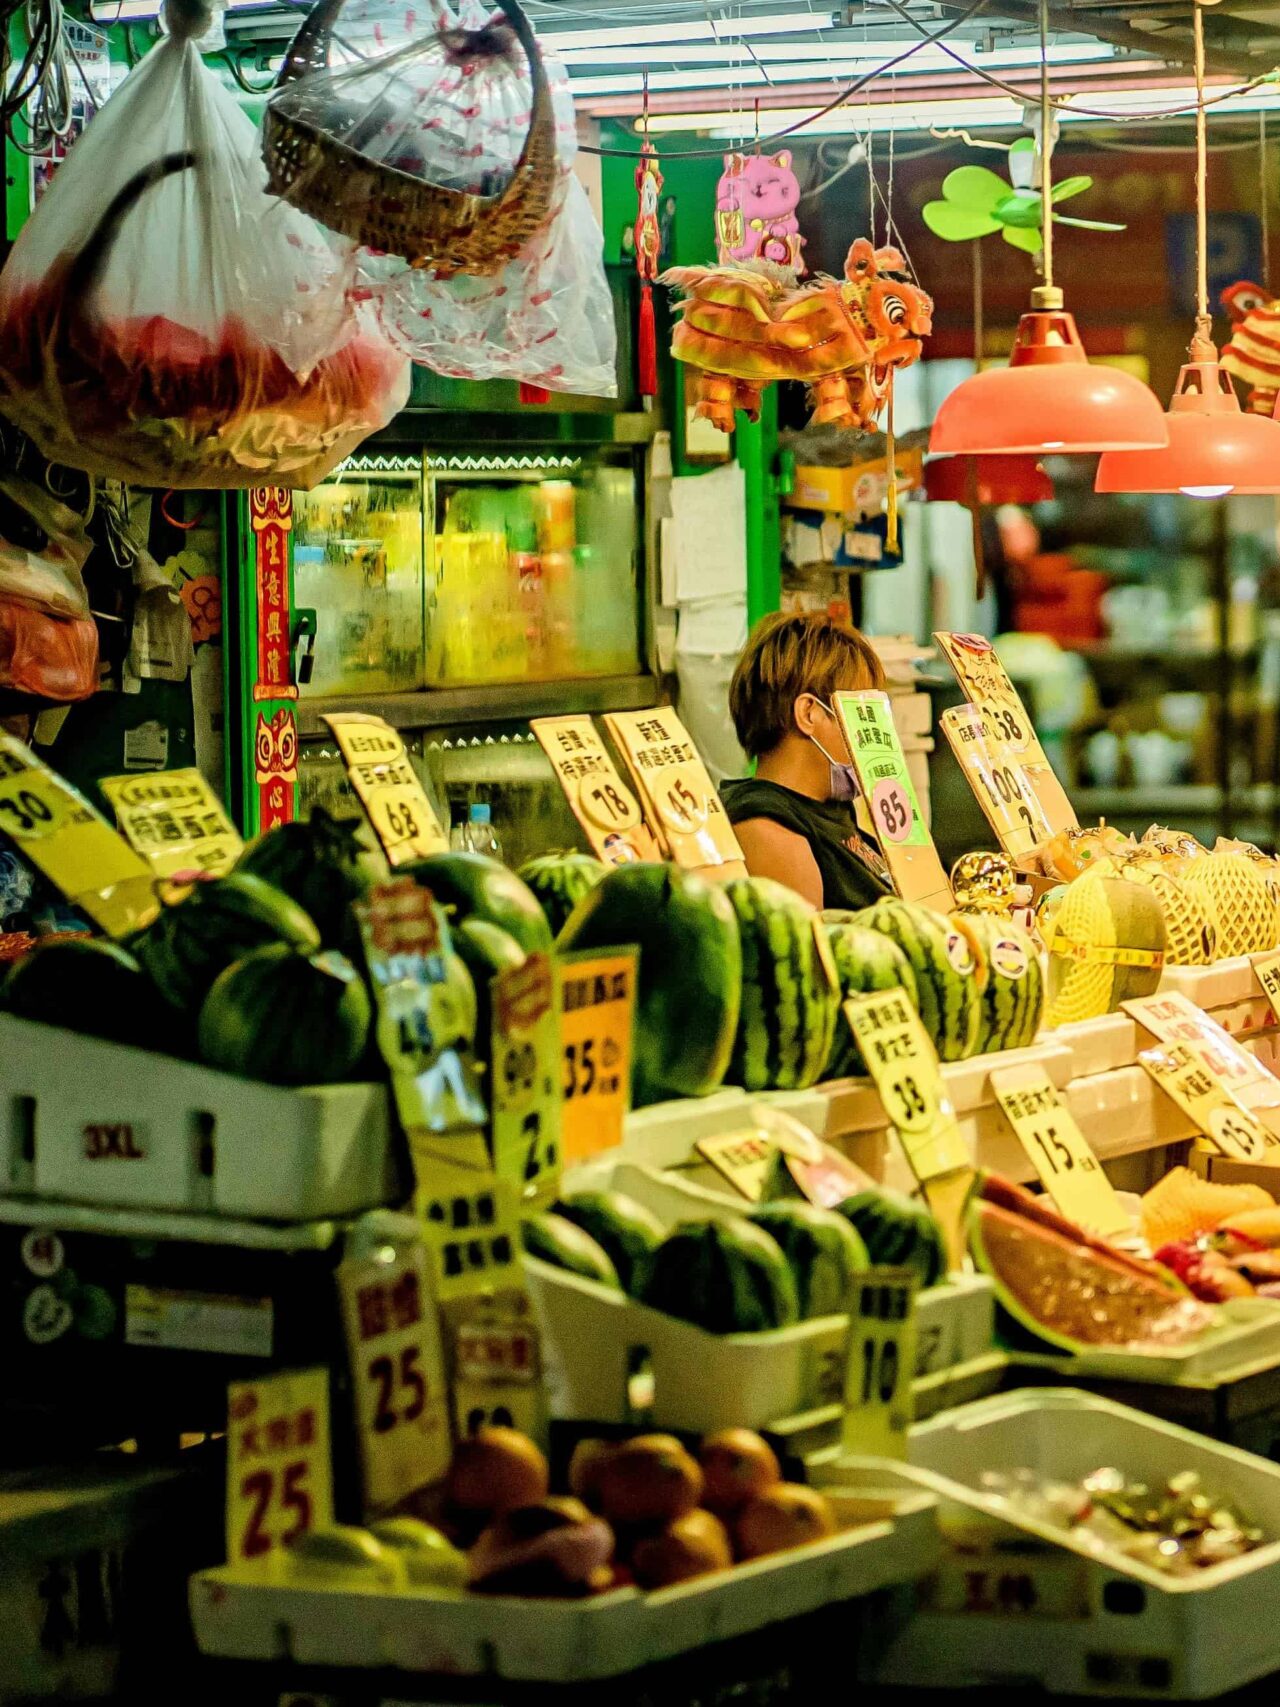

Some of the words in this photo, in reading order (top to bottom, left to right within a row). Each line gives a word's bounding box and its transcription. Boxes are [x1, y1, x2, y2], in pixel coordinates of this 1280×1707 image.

[264, 530, 281, 684] 生意興隆
[958, 723, 992, 744] 店長推介
[591, 784, 629, 821] 78
[667, 779, 699, 822] 45
[979, 766, 1023, 808] 100
[0, 790, 53, 830] 30
[385, 802, 419, 838] 68
[880, 790, 907, 835] 85
[564, 1039, 596, 1099] 35
[82, 1123, 147, 1160] 3XL
[1033, 1127, 1074, 1174] 15
[1221, 1118, 1255, 1155] 25
[368, 1347, 428, 1434] 25
[862, 1337, 899, 1403] 10
[240, 1461, 313, 1558] 25
